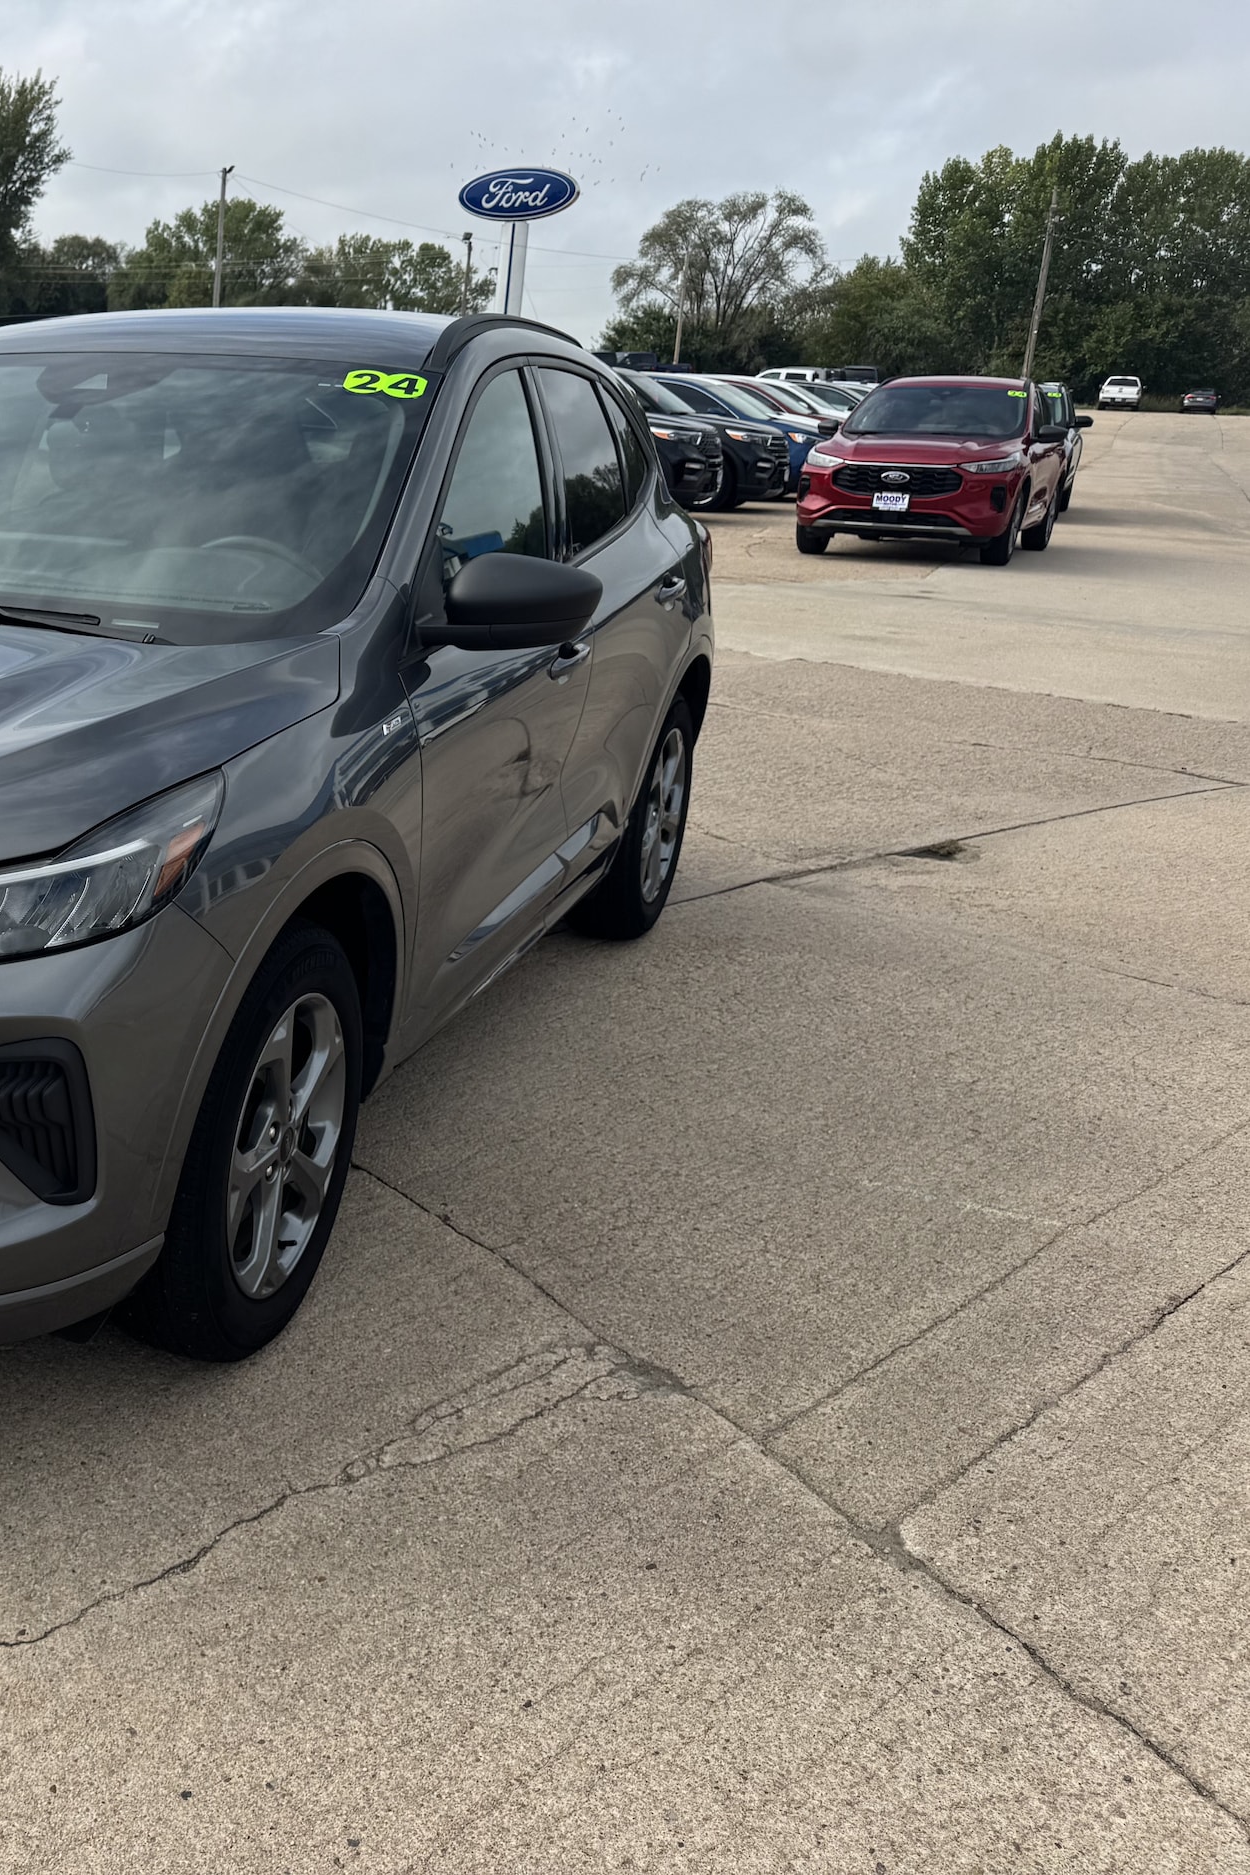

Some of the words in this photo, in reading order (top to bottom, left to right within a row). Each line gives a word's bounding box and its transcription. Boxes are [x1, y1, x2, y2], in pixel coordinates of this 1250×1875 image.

[481, 178, 550, 209] Ford
[349, 372, 419, 396] 24
[875, 495, 907, 503] MOODY
